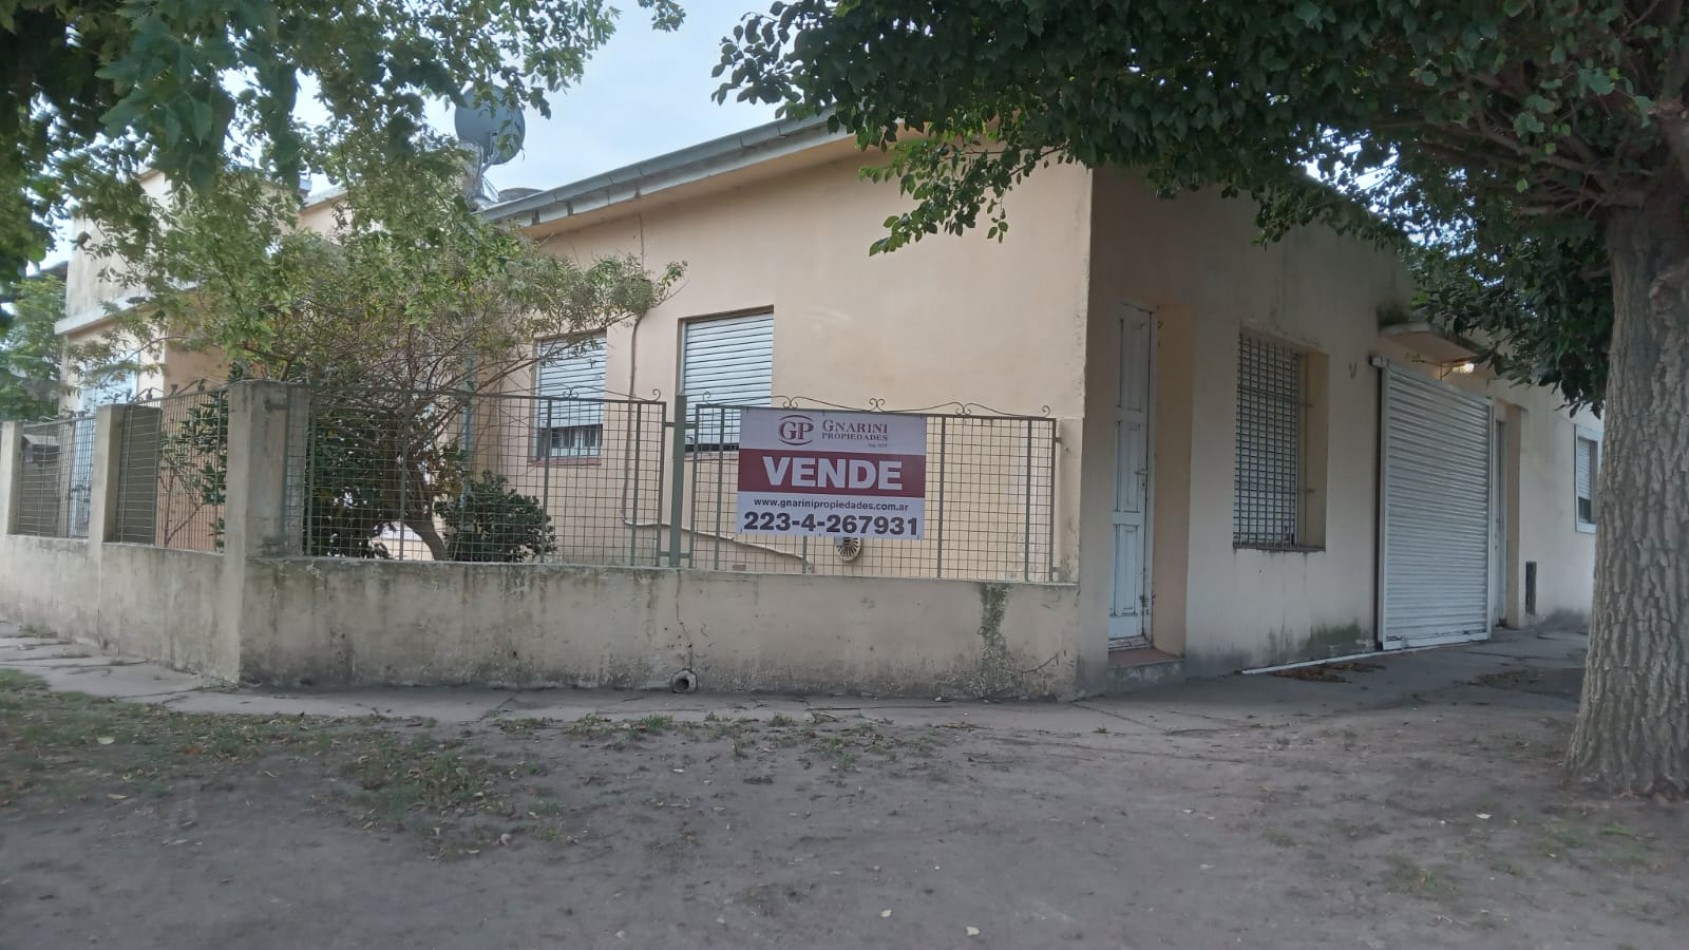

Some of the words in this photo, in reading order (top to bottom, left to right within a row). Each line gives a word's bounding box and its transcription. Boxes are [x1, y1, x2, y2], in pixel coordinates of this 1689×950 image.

[779, 420, 814, 441] GP
[822, 419, 888, 434] GNARINI
[821, 432, 888, 441] PROPIEDADES
[762, 456, 903, 491] VENDE
[754, 498, 909, 512] www.gnarinipropiedades.com.ar
[743, 511, 917, 536] 223-4-267931
